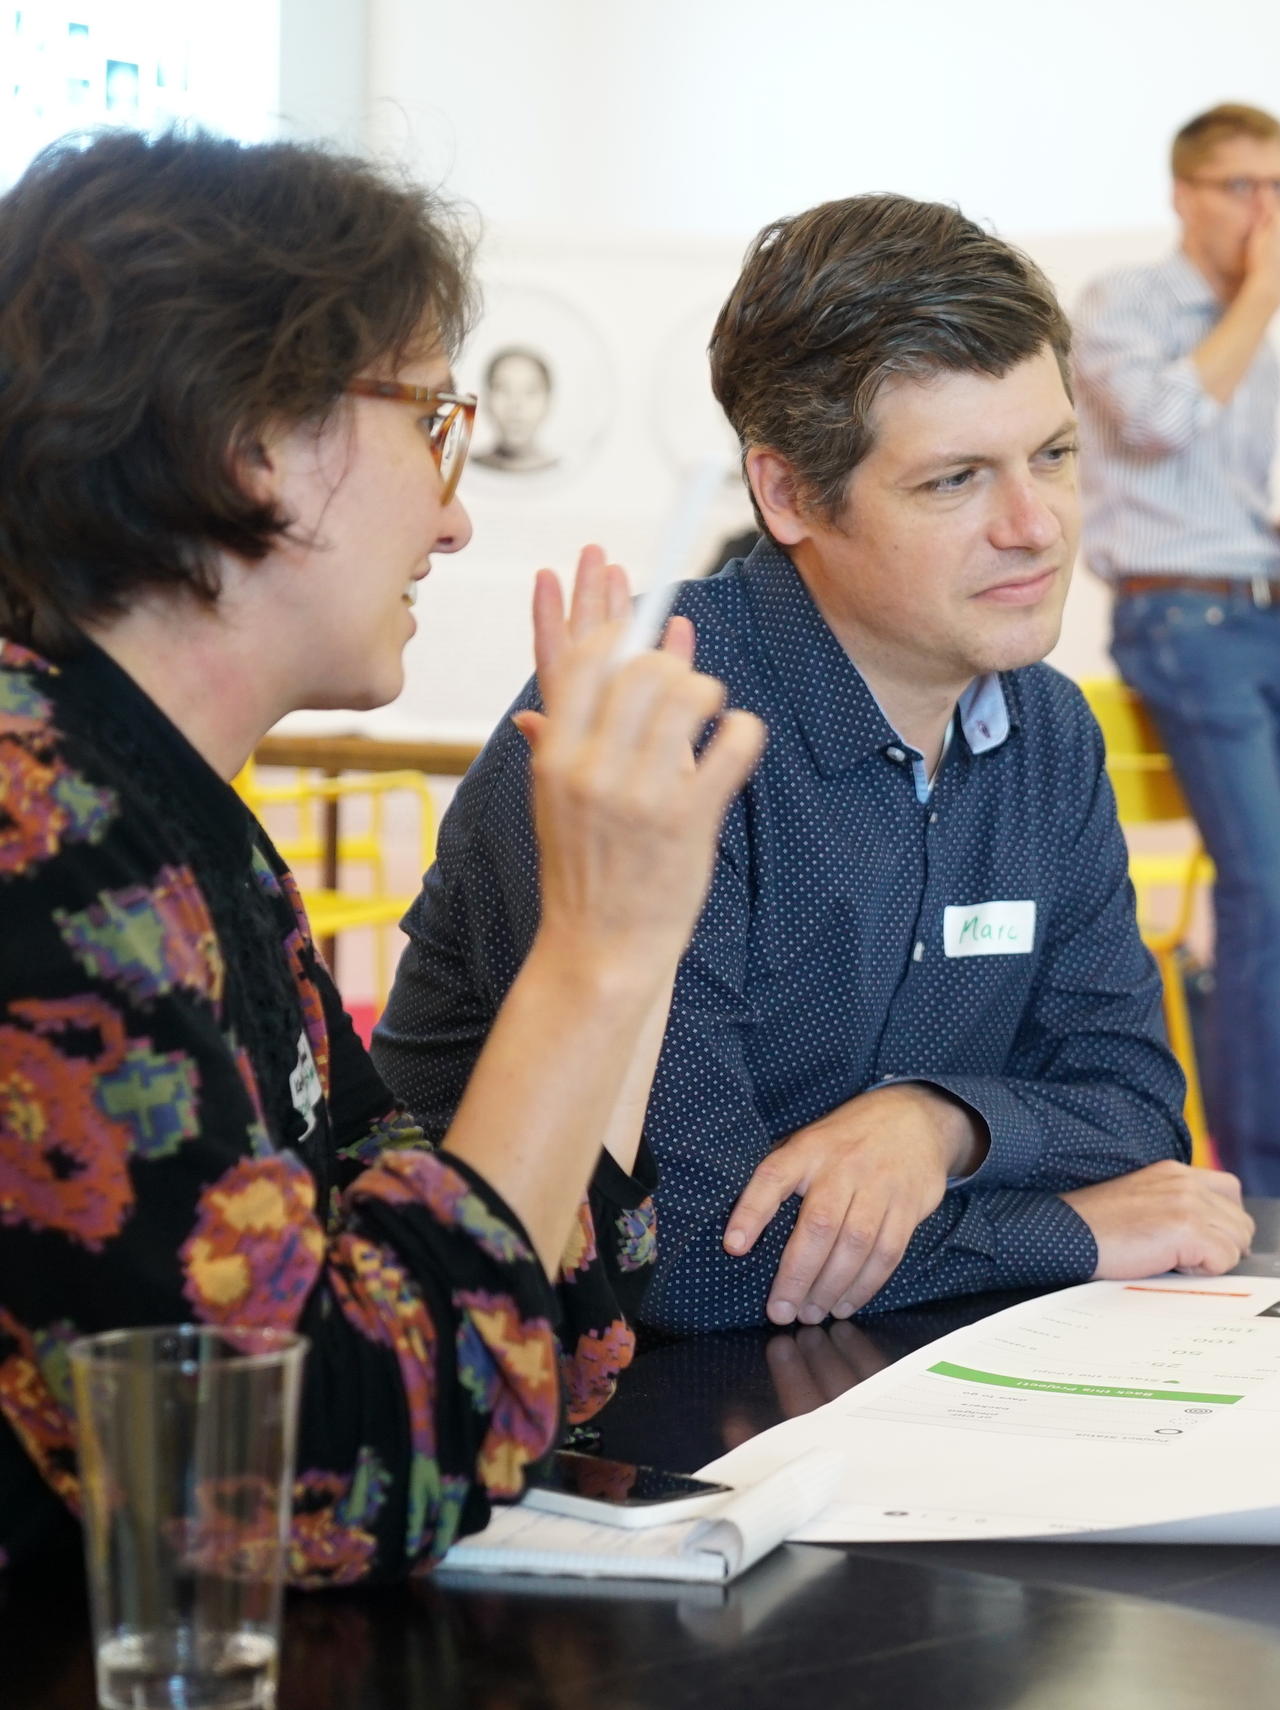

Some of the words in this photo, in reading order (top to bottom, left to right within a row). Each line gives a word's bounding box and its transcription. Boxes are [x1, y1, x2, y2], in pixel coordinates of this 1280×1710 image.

[958, 915, 1018, 945] Marc
[1016, 1381, 1078, 1392] Project!
[1115, 1389, 1154, 1397] Back
